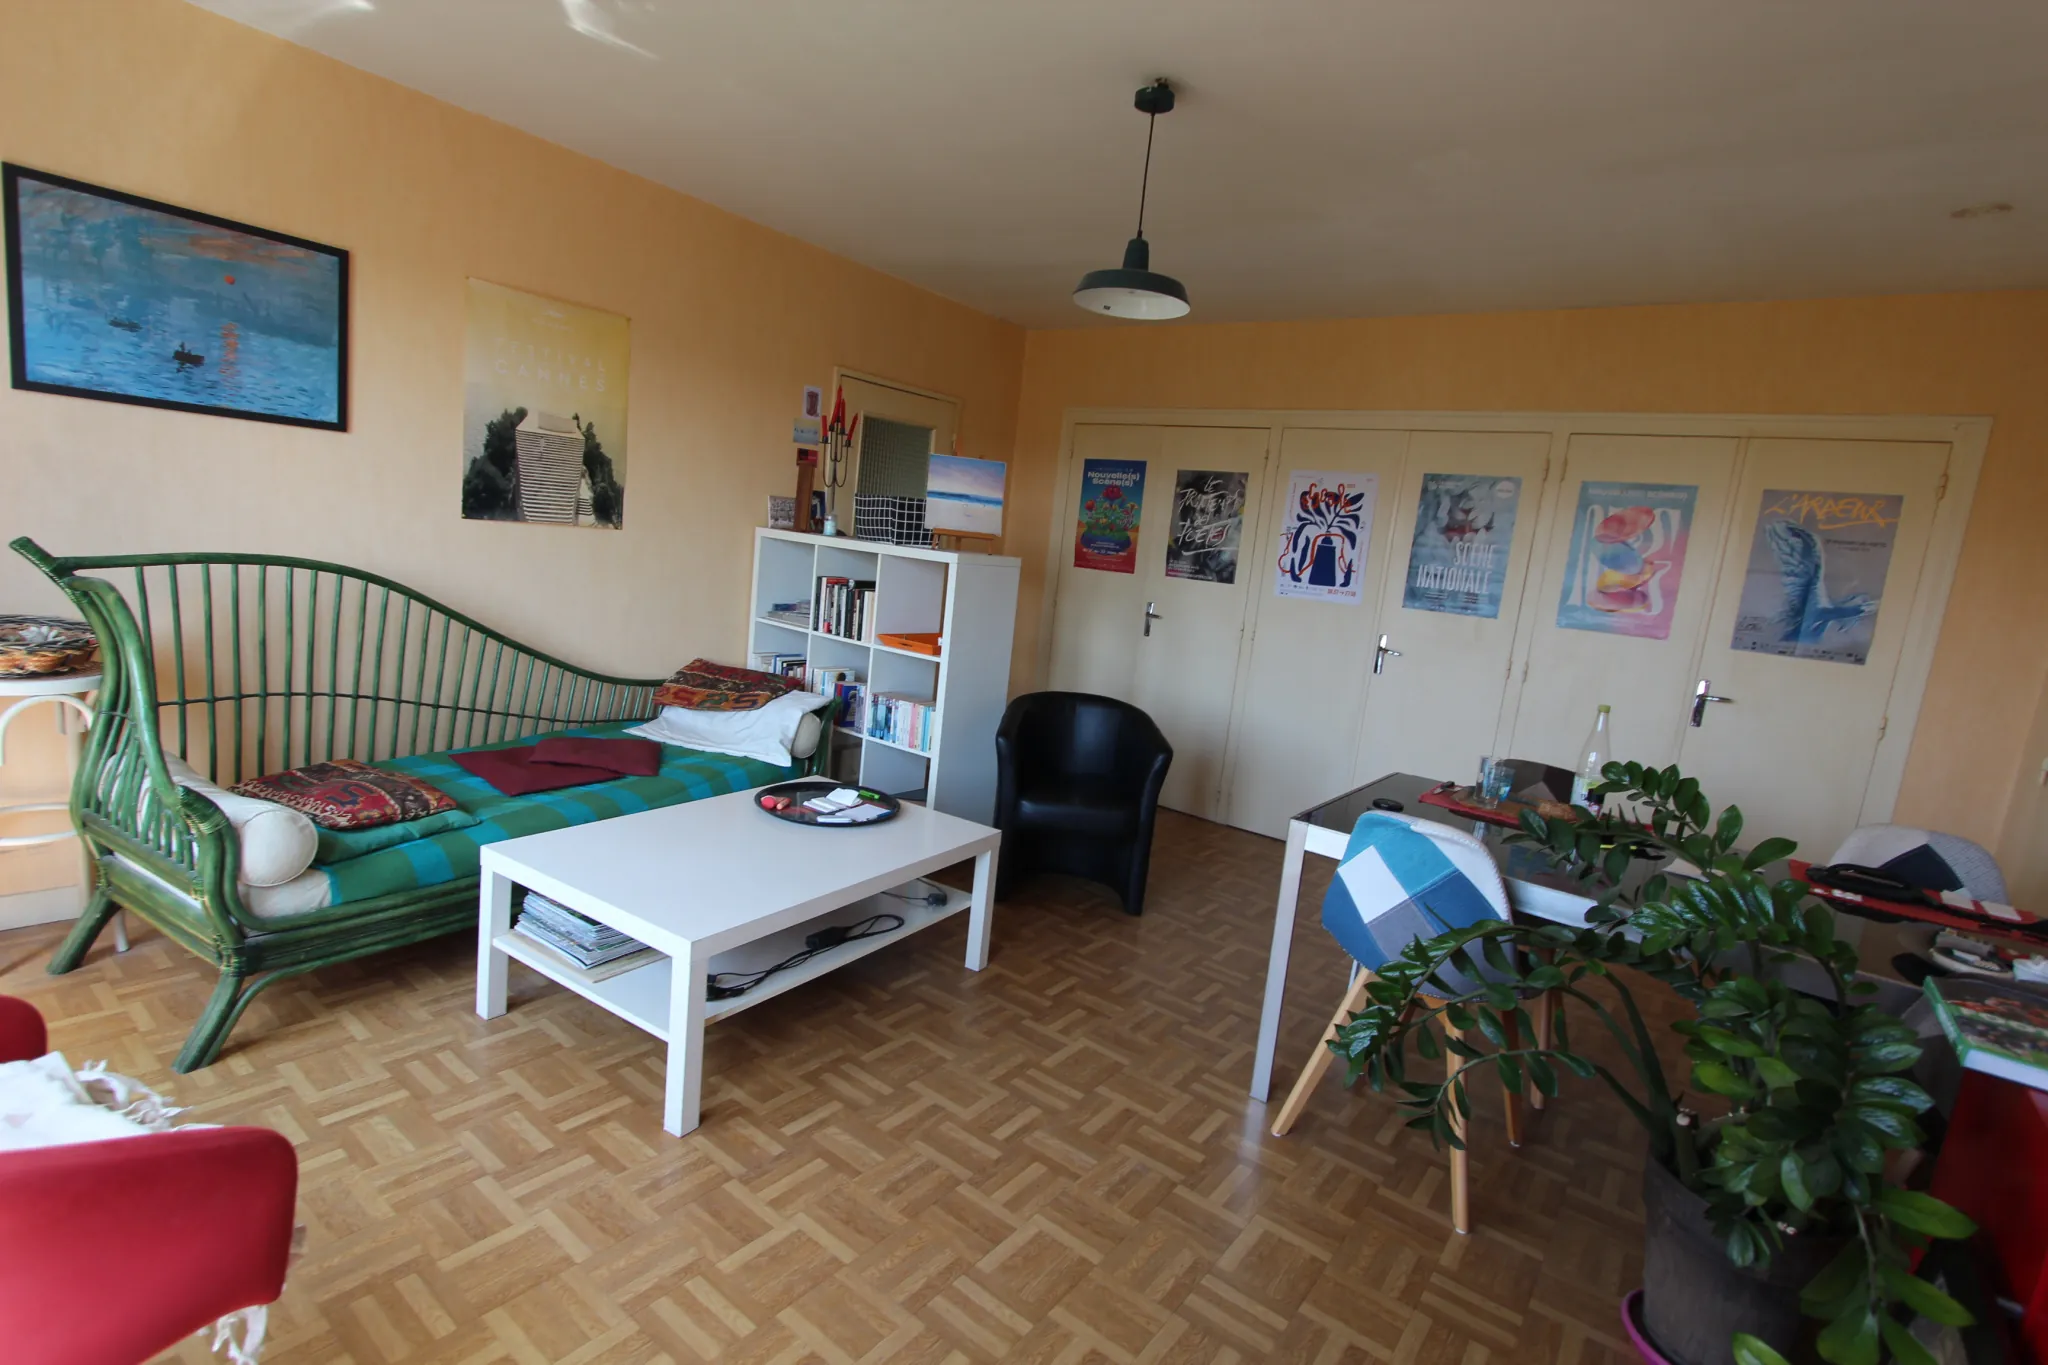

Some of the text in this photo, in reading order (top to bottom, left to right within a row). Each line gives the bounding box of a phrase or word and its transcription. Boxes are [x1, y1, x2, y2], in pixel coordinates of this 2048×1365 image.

[494, 358, 605, 392] CANNES
[1087, 471, 1140, 482] Nouvelle(s)
[1416, 564, 1493, 595] NATIONALE
